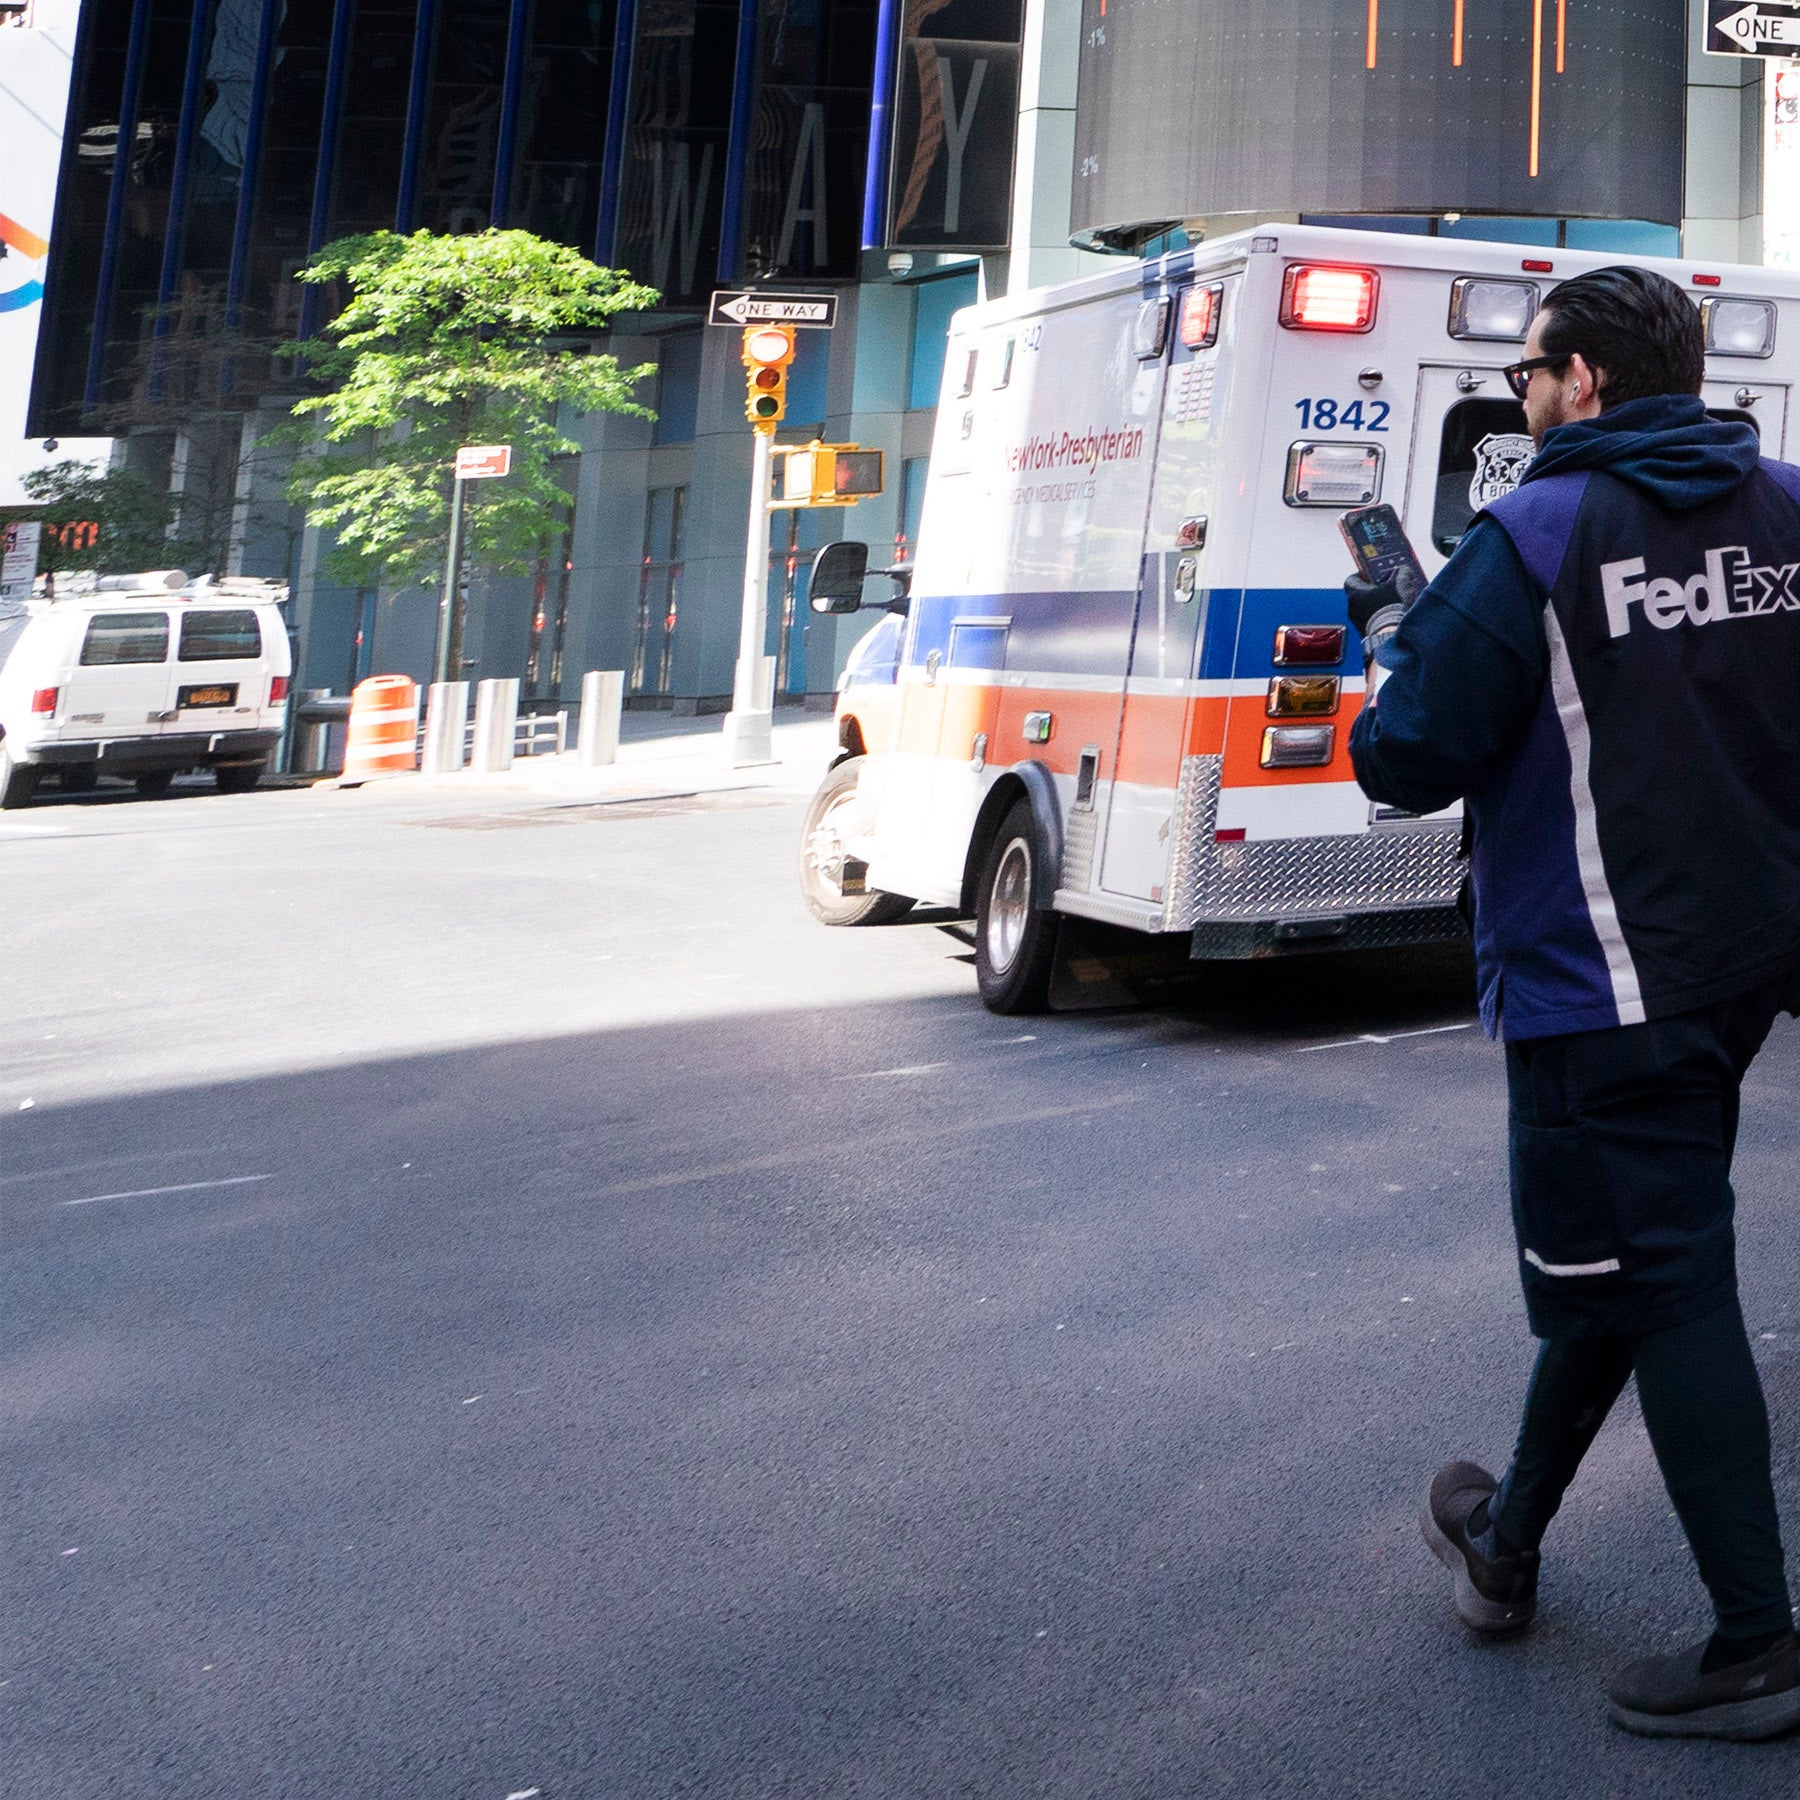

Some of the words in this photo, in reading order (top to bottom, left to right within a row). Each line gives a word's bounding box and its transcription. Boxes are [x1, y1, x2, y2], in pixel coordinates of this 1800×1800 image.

[1735, 17, 1783, 41] ONE
[735, 301, 771, 317] ONE
[782, 303, 819, 319] WAY
[1294, 398, 1390, 432] 1842
